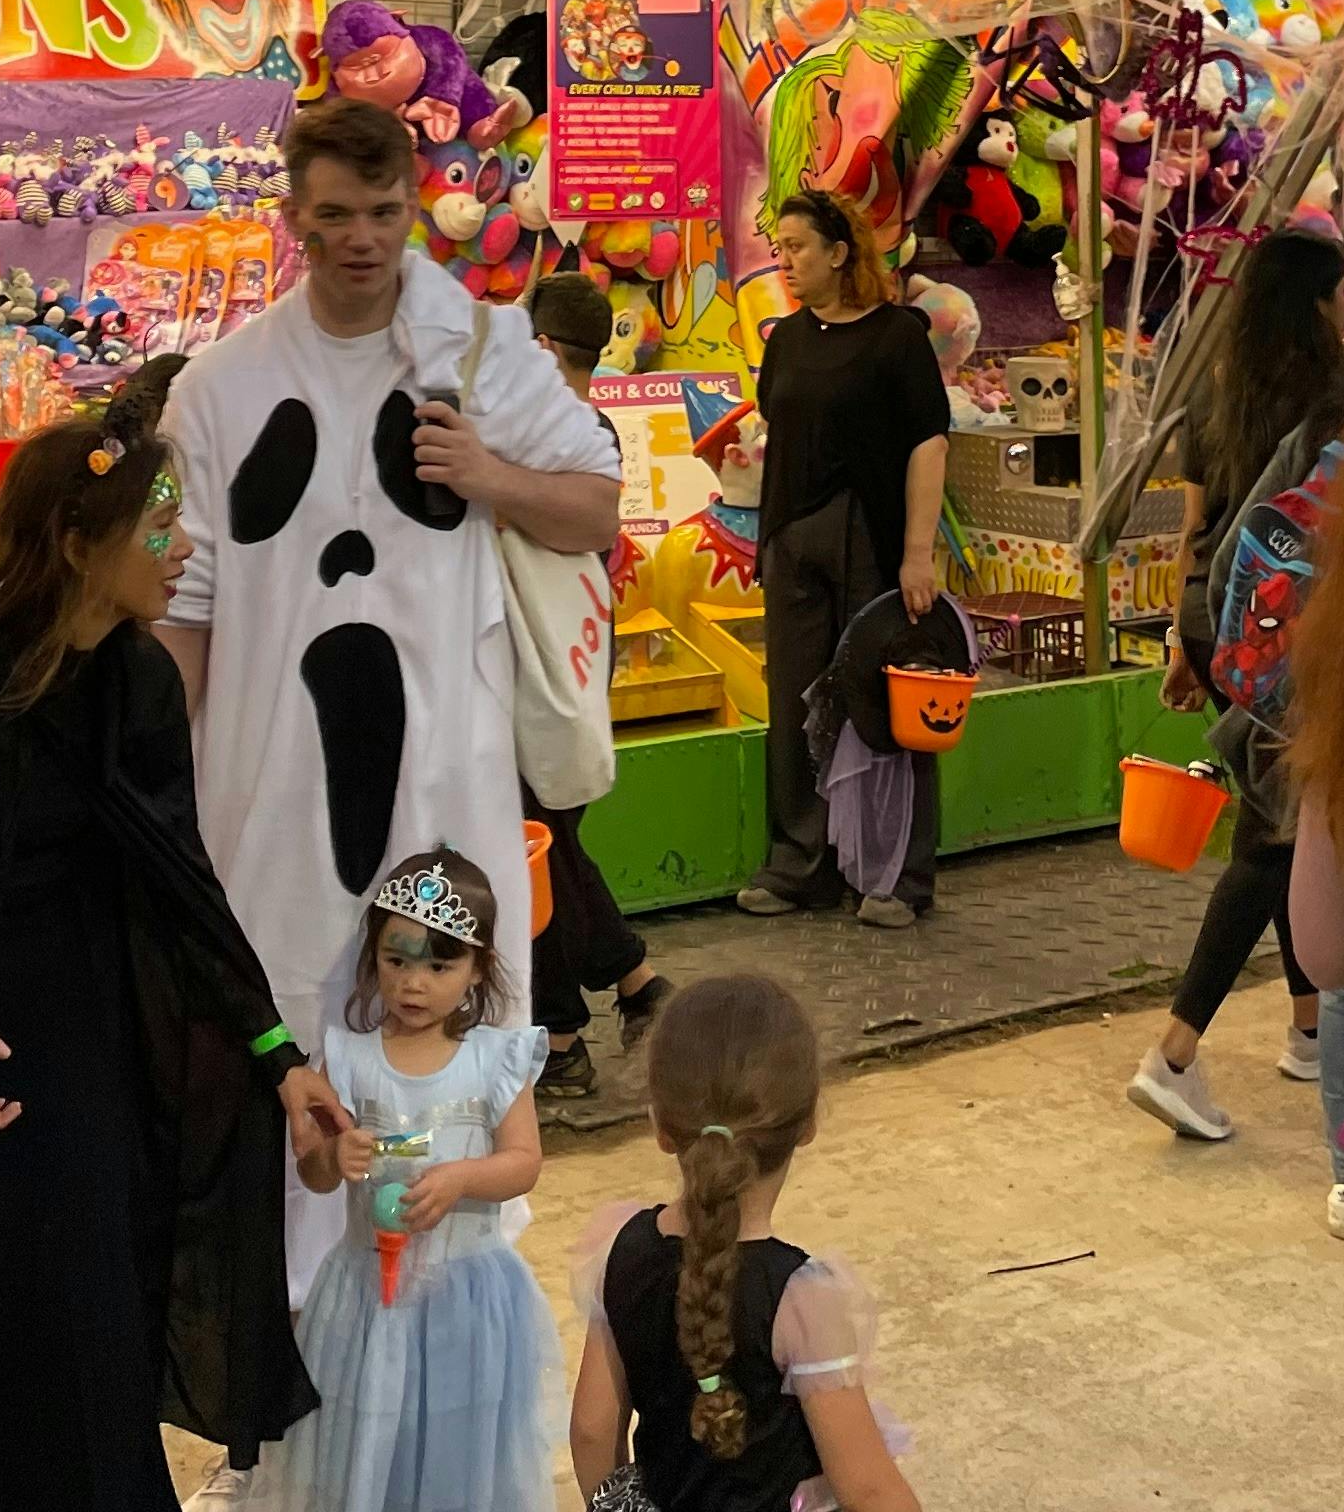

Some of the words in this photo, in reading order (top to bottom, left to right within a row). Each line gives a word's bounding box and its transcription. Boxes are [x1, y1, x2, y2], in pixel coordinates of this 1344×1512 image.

[589, 385, 622, 401] ASH
[626, 383, 642, 399] &
[644, 380, 731, 398] COUNS
